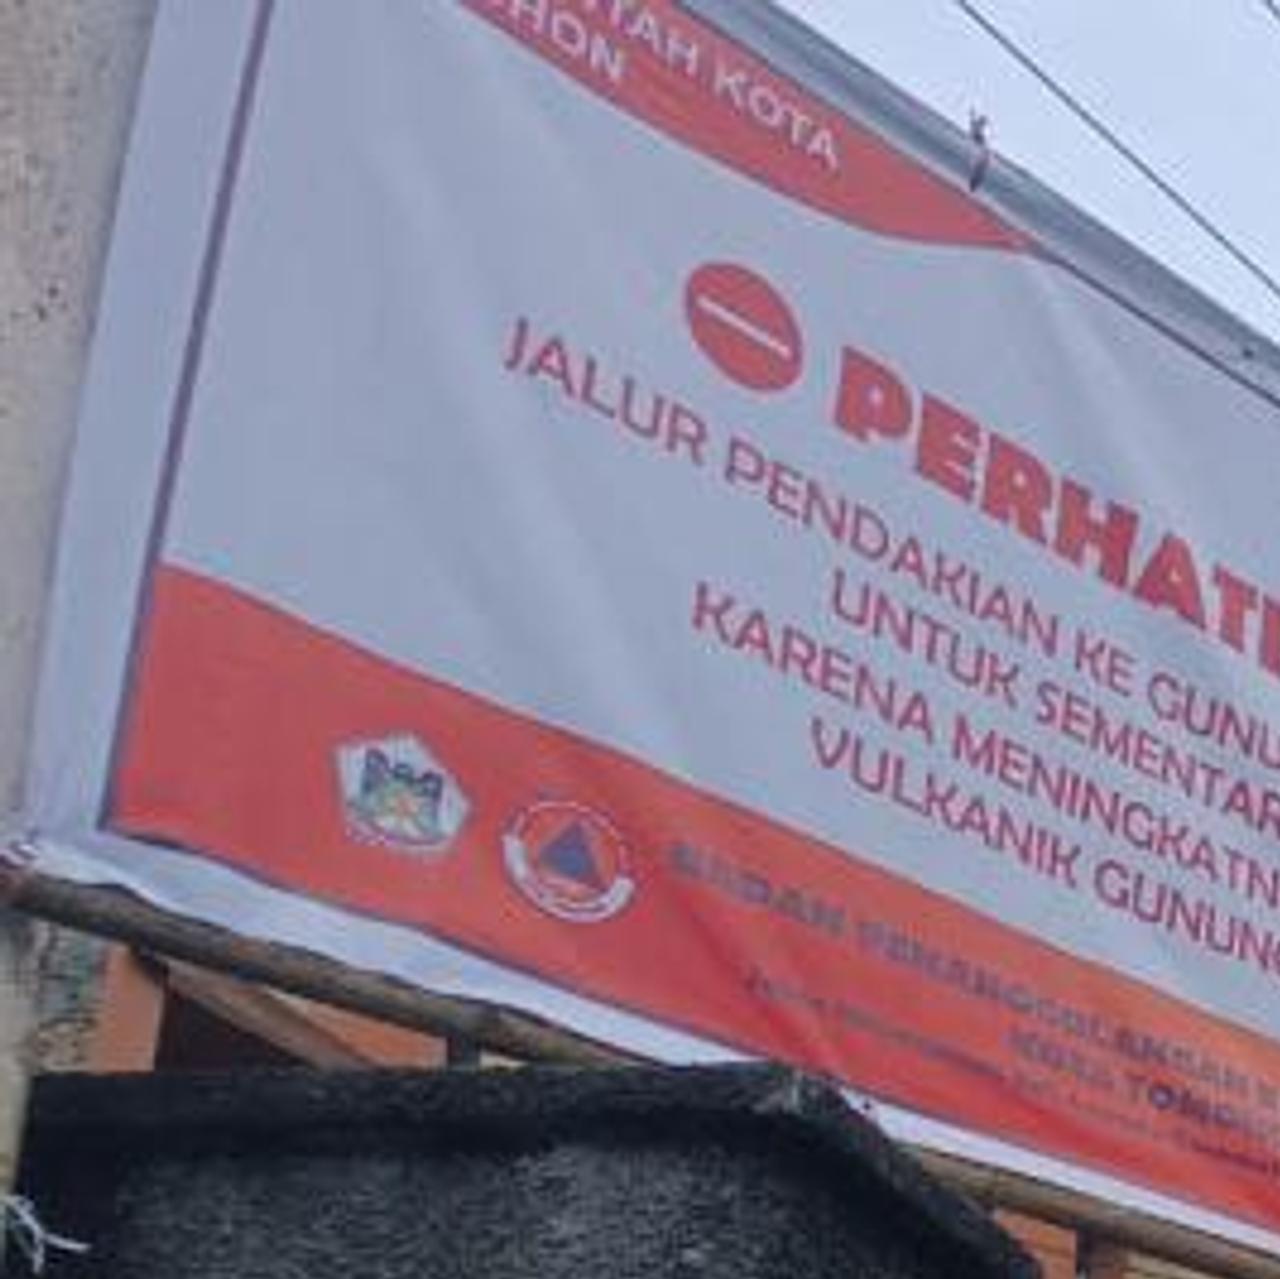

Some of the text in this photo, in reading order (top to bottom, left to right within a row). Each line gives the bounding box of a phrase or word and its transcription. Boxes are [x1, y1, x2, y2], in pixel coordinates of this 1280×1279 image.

[713, 62, 840, 171] KOTA
[503, 317, 708, 466] JALUR
[725, 436, 1058, 658] PENDAKIAN
[1074, 630, 1135, 698] KE
[692, 581, 933, 745] KARENA
[832, 568, 1020, 708] UNTUK
[810, 715, 1081, 889] VULKANIK
